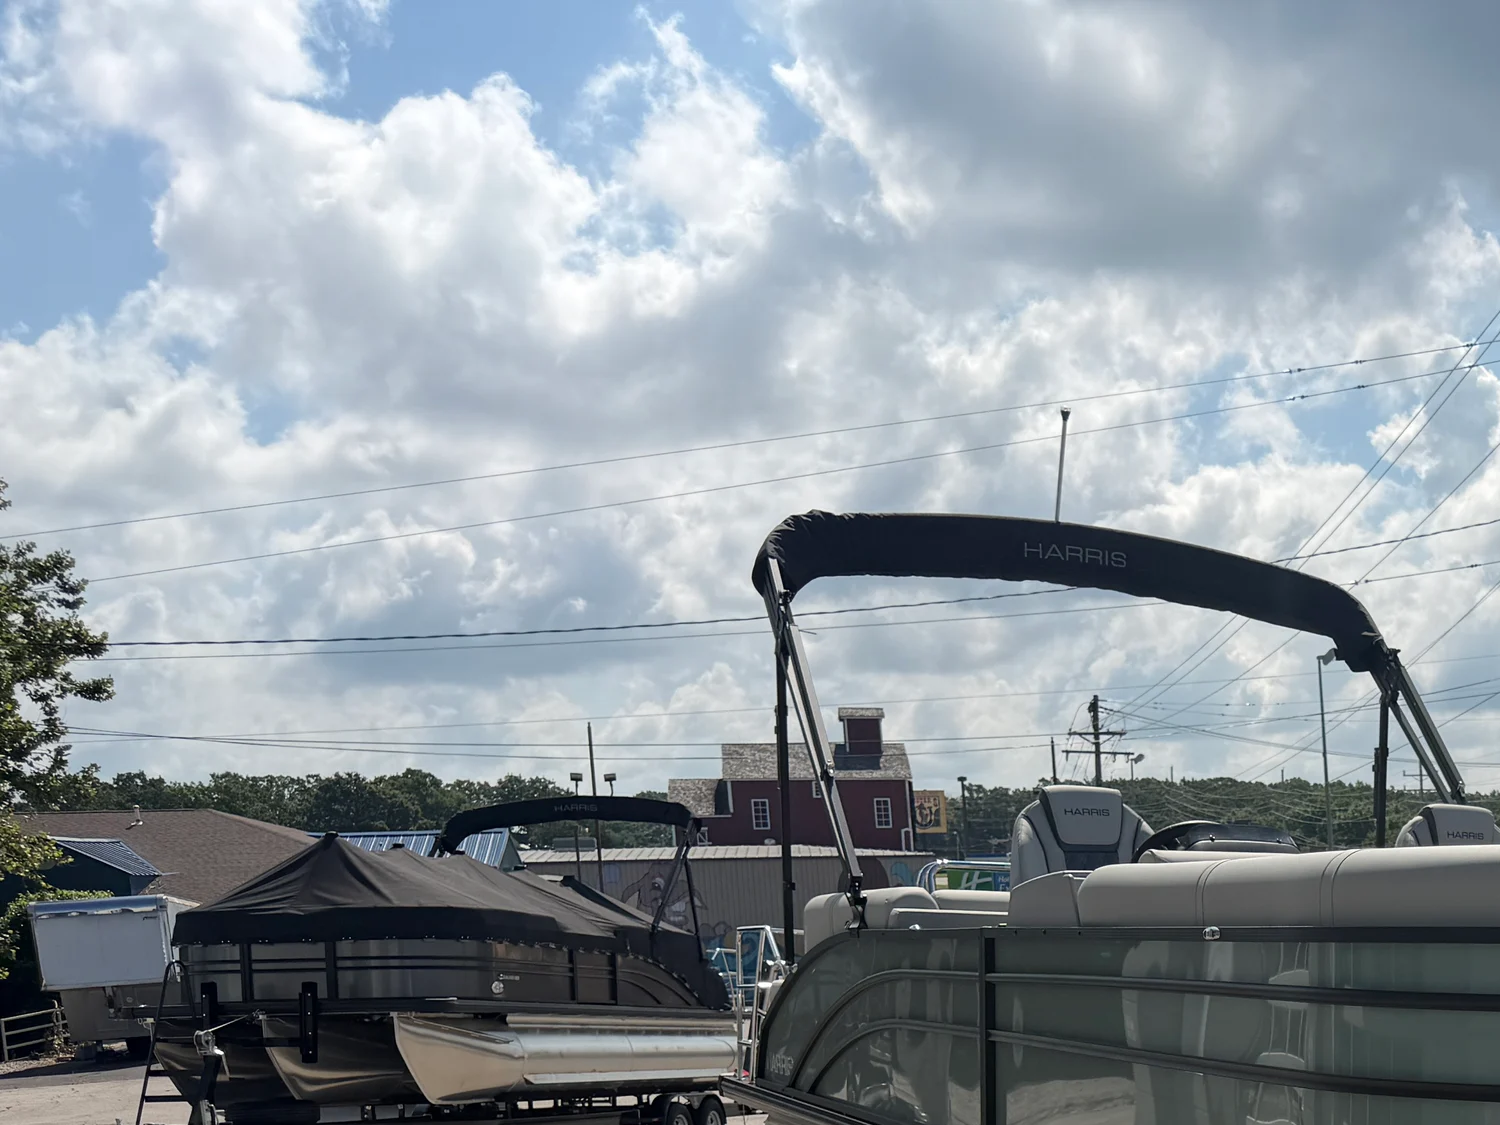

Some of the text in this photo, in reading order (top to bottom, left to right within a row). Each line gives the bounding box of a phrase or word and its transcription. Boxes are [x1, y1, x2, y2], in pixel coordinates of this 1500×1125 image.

[1024, 542, 1127, 568] HARRIS
[1063, 808, 1110, 817] HARRIS
[1447, 831, 1484, 841] HARRIS
